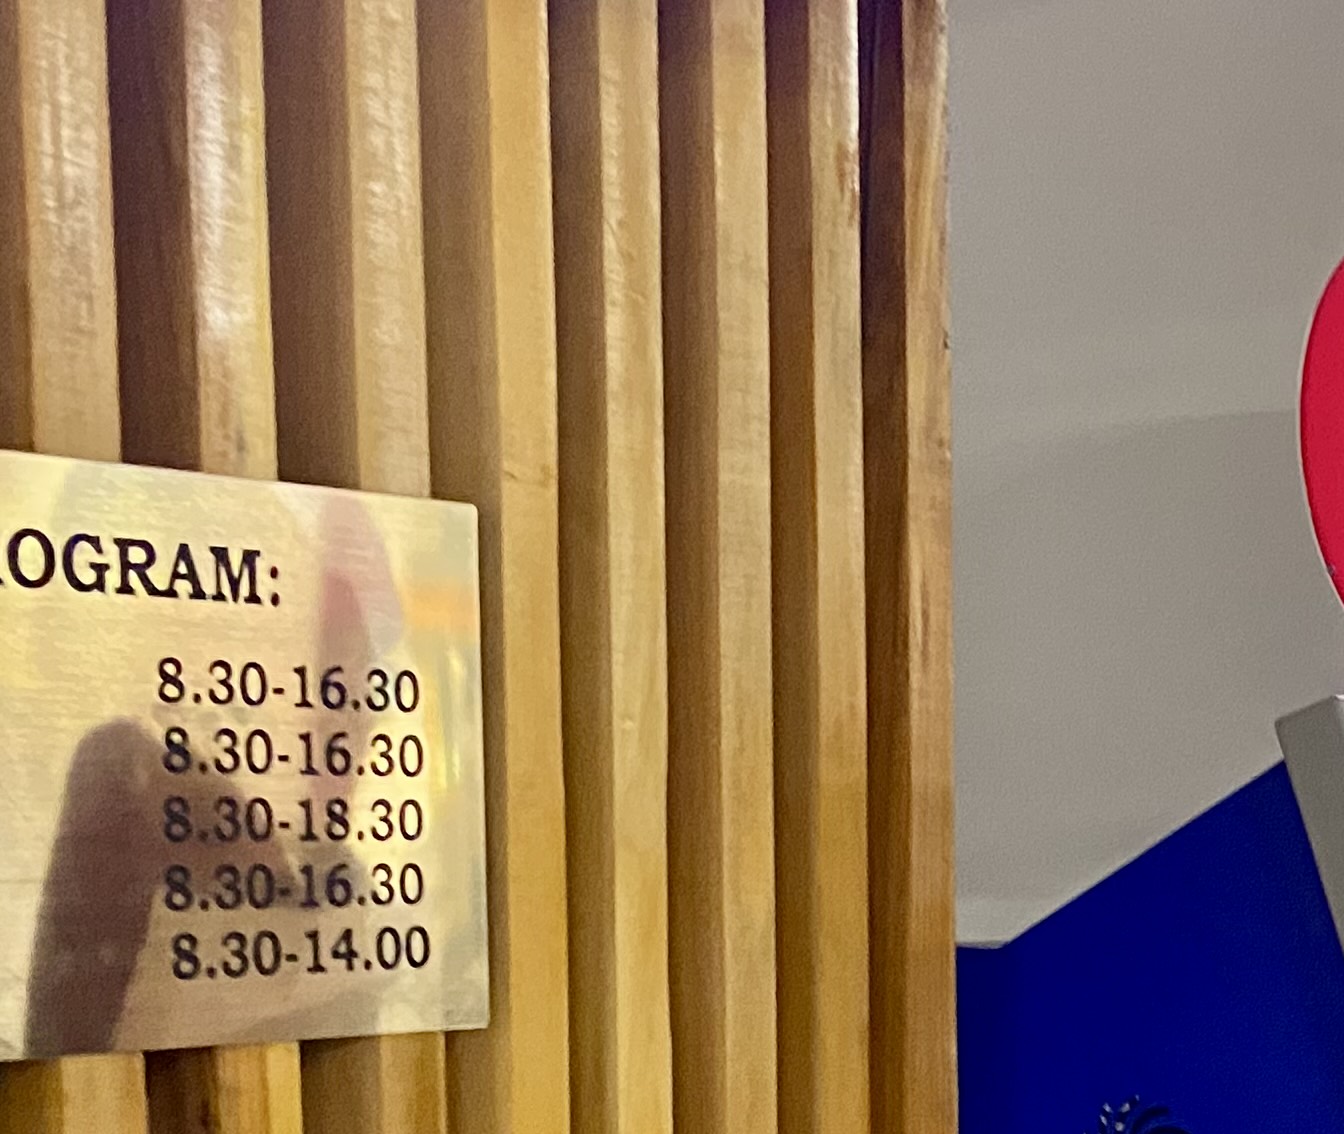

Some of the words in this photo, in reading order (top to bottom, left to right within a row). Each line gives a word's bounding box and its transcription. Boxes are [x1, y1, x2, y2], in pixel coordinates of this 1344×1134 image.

[0, 528, 281, 607] OGRAM:
[157, 657, 420, 713] 8.30-16.30
[162, 726, 425, 778] 8.30-16.30
[162, 796, 425, 843] 8.30-18.30
[163, 863, 425, 911] 8.30-16.30
[171, 925, 432, 980] 8.30-14.00
